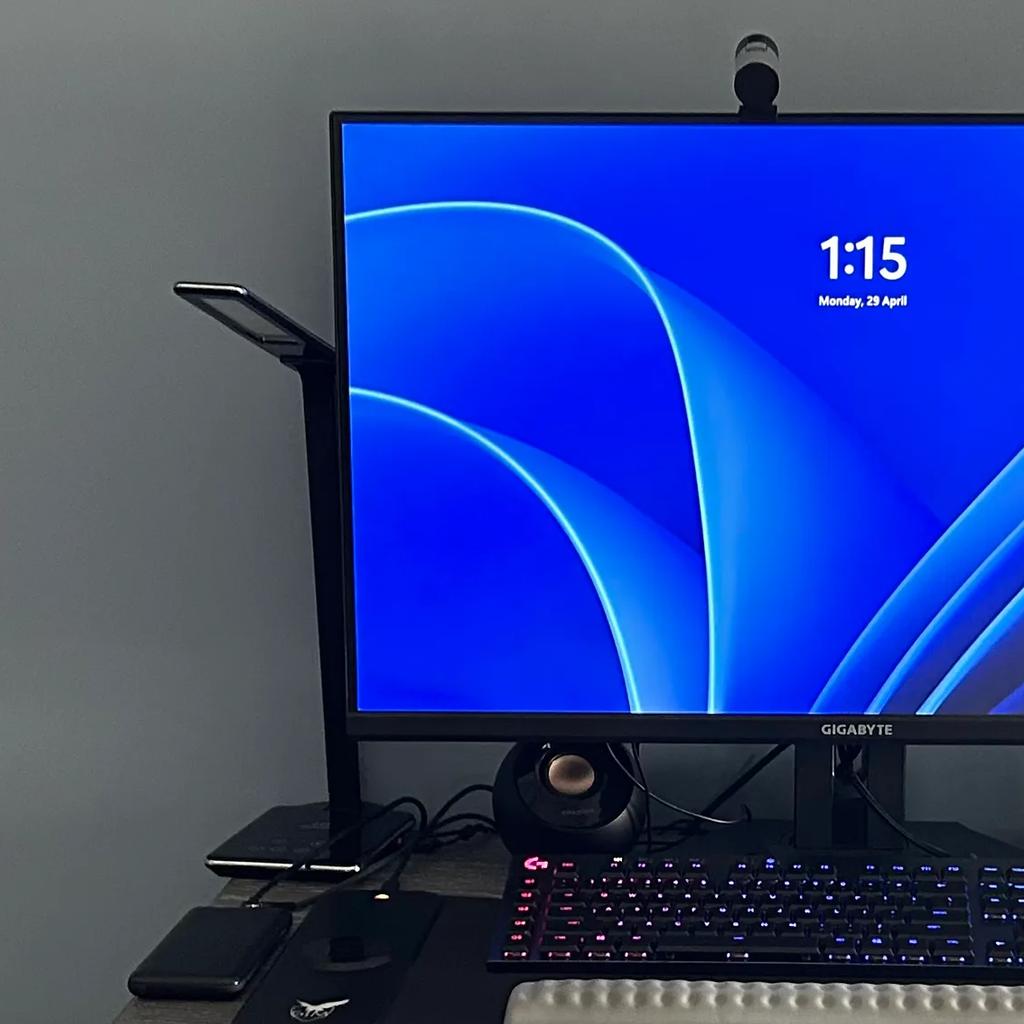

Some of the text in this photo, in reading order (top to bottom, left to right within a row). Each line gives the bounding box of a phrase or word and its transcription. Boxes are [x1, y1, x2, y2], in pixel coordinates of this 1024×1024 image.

[820, 235, 907, 281] 1:15
[818, 294, 908, 309] Monday, 29 April
[821, 724, 893, 735] GIGABYTE
